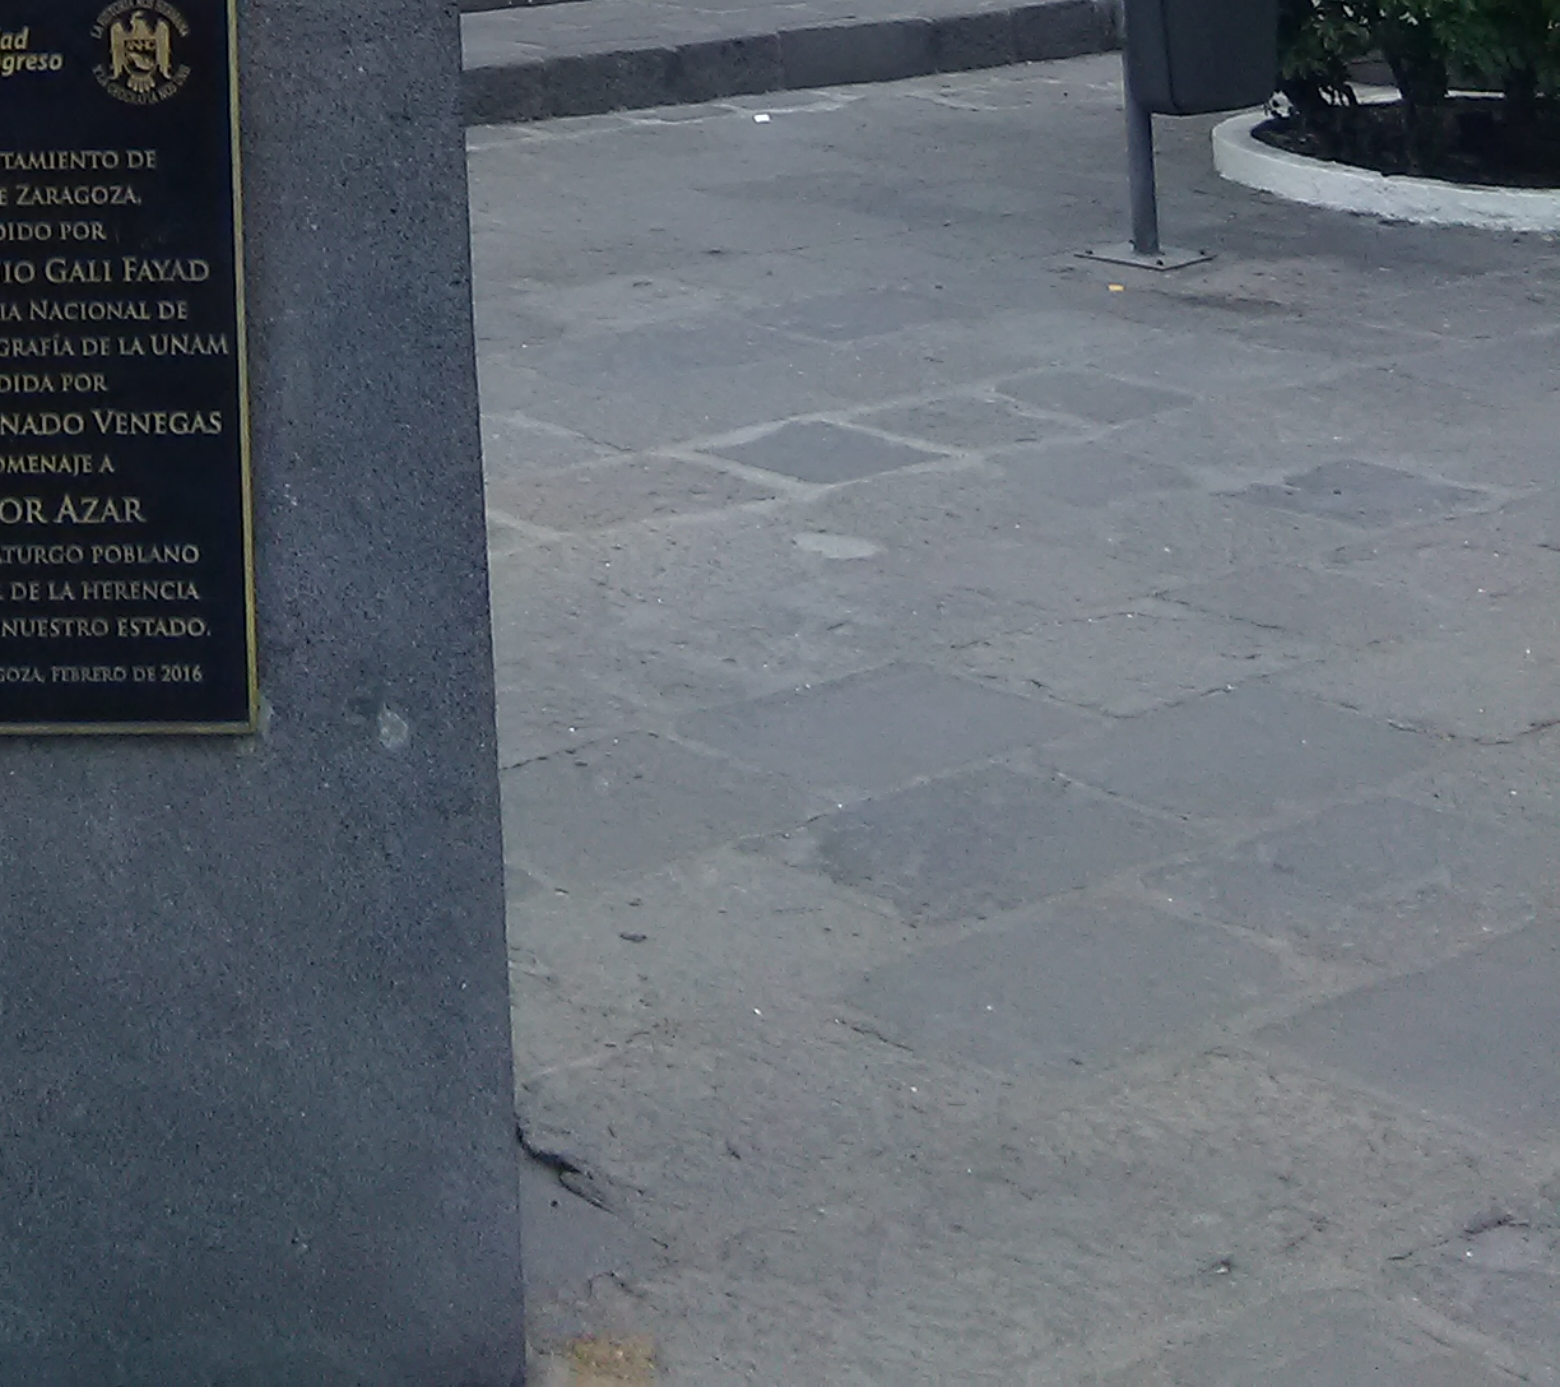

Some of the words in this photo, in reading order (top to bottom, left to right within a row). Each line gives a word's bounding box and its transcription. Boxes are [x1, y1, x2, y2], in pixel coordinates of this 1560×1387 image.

[126, 150, 155, 168] DE
[60, 222, 106, 240] POR
[45, 258, 111, 282] GALI
[122, 257, 209, 281] FAYAD
[30, 300, 150, 320] NACIONAL
[158, 301, 187, 319] DE
[82, 338, 110, 355] DE
[119, 337, 145, 355] LA
[150, 334, 228, 355] UNAM
[61, 374, 107, 391] POR
[92, 410, 221, 434] VENEGAS
[99, 455, 114, 472] A
[54, 495, 145, 523] AZAR
[91, 544, 199, 563] POBLANO
[11, 582, 39, 601] DE
[49, 582, 75, 600] LA
[81, 581, 200, 600] HERENCIA
[2, 618, 109, 637] NUESTRO
[118, 618, 210, 636] ESTADO.
[51, 666, 126, 682] FEBRERO
[133, 666, 155, 682] DE
[162, 665, 202, 682] 2016
